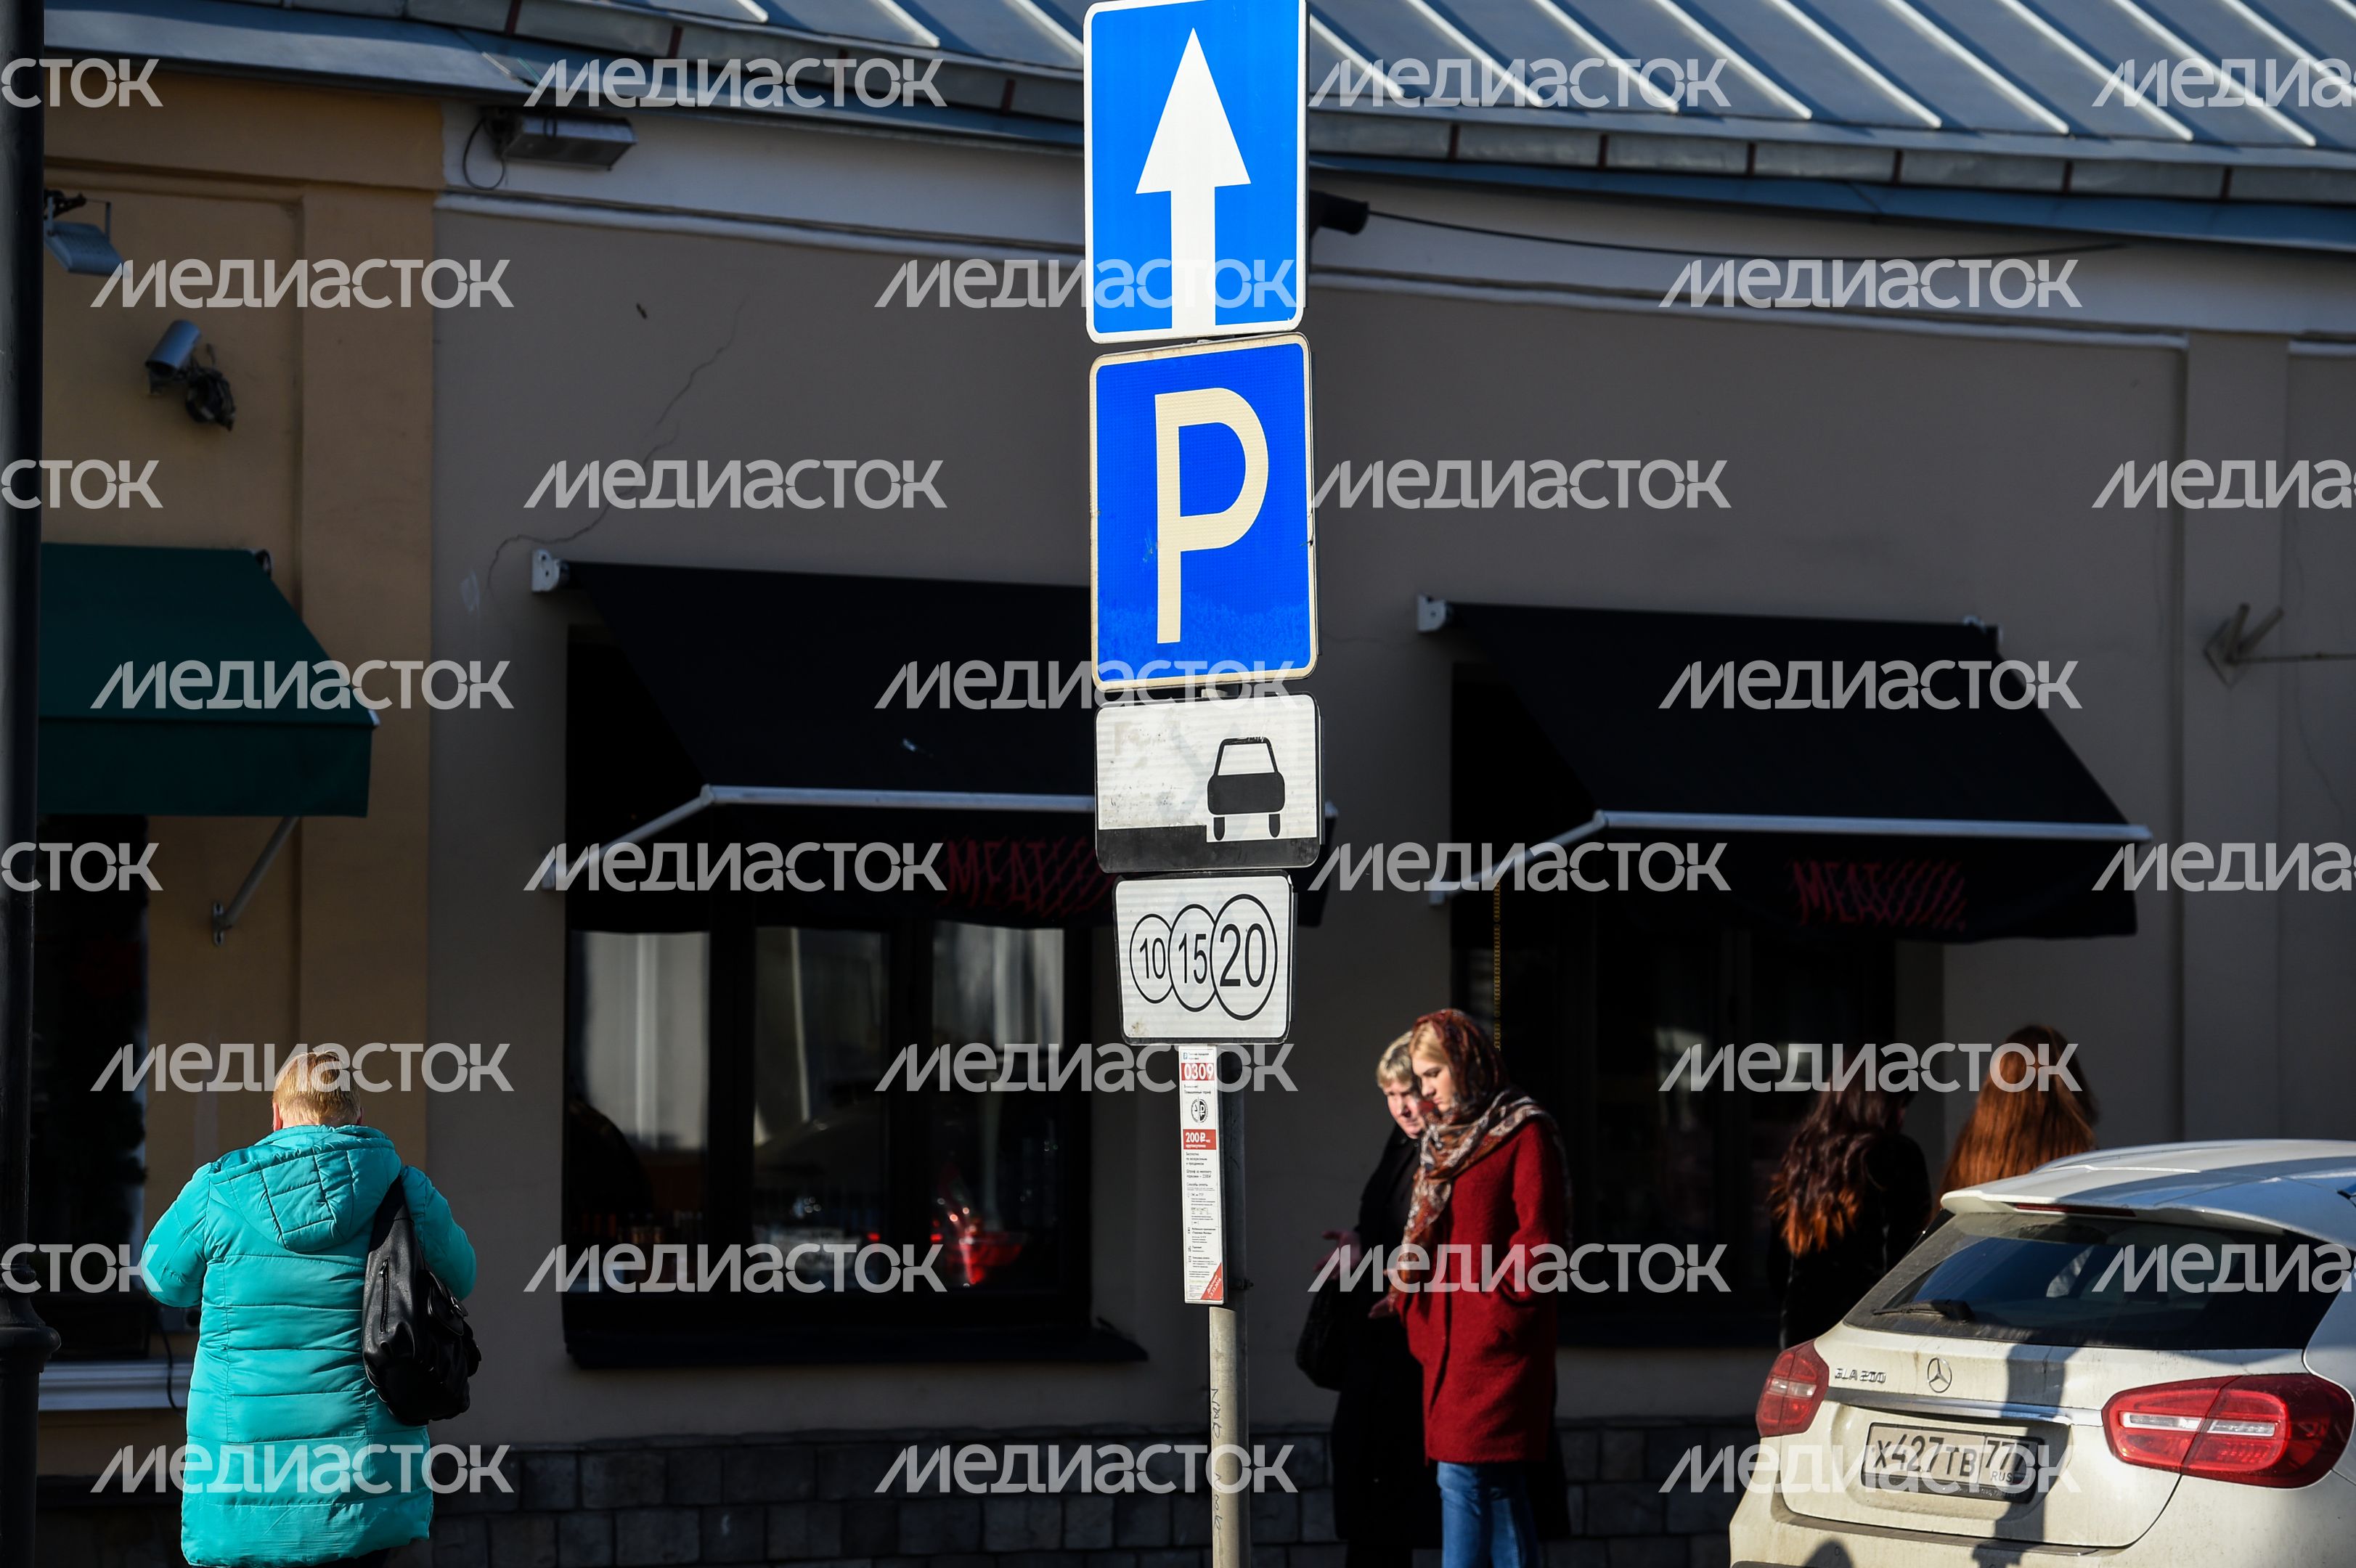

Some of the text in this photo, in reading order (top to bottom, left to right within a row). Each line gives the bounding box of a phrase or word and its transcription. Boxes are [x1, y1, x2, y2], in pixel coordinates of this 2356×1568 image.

[1154, 387, 1269, 644] P
[1139, 923, 1267, 988] 10 15 20
[1184, 1063, 1214, 1079] 0309
[1859, 1370, 1887, 1384] 200
[1990, 1470, 2013, 1483] RUS
